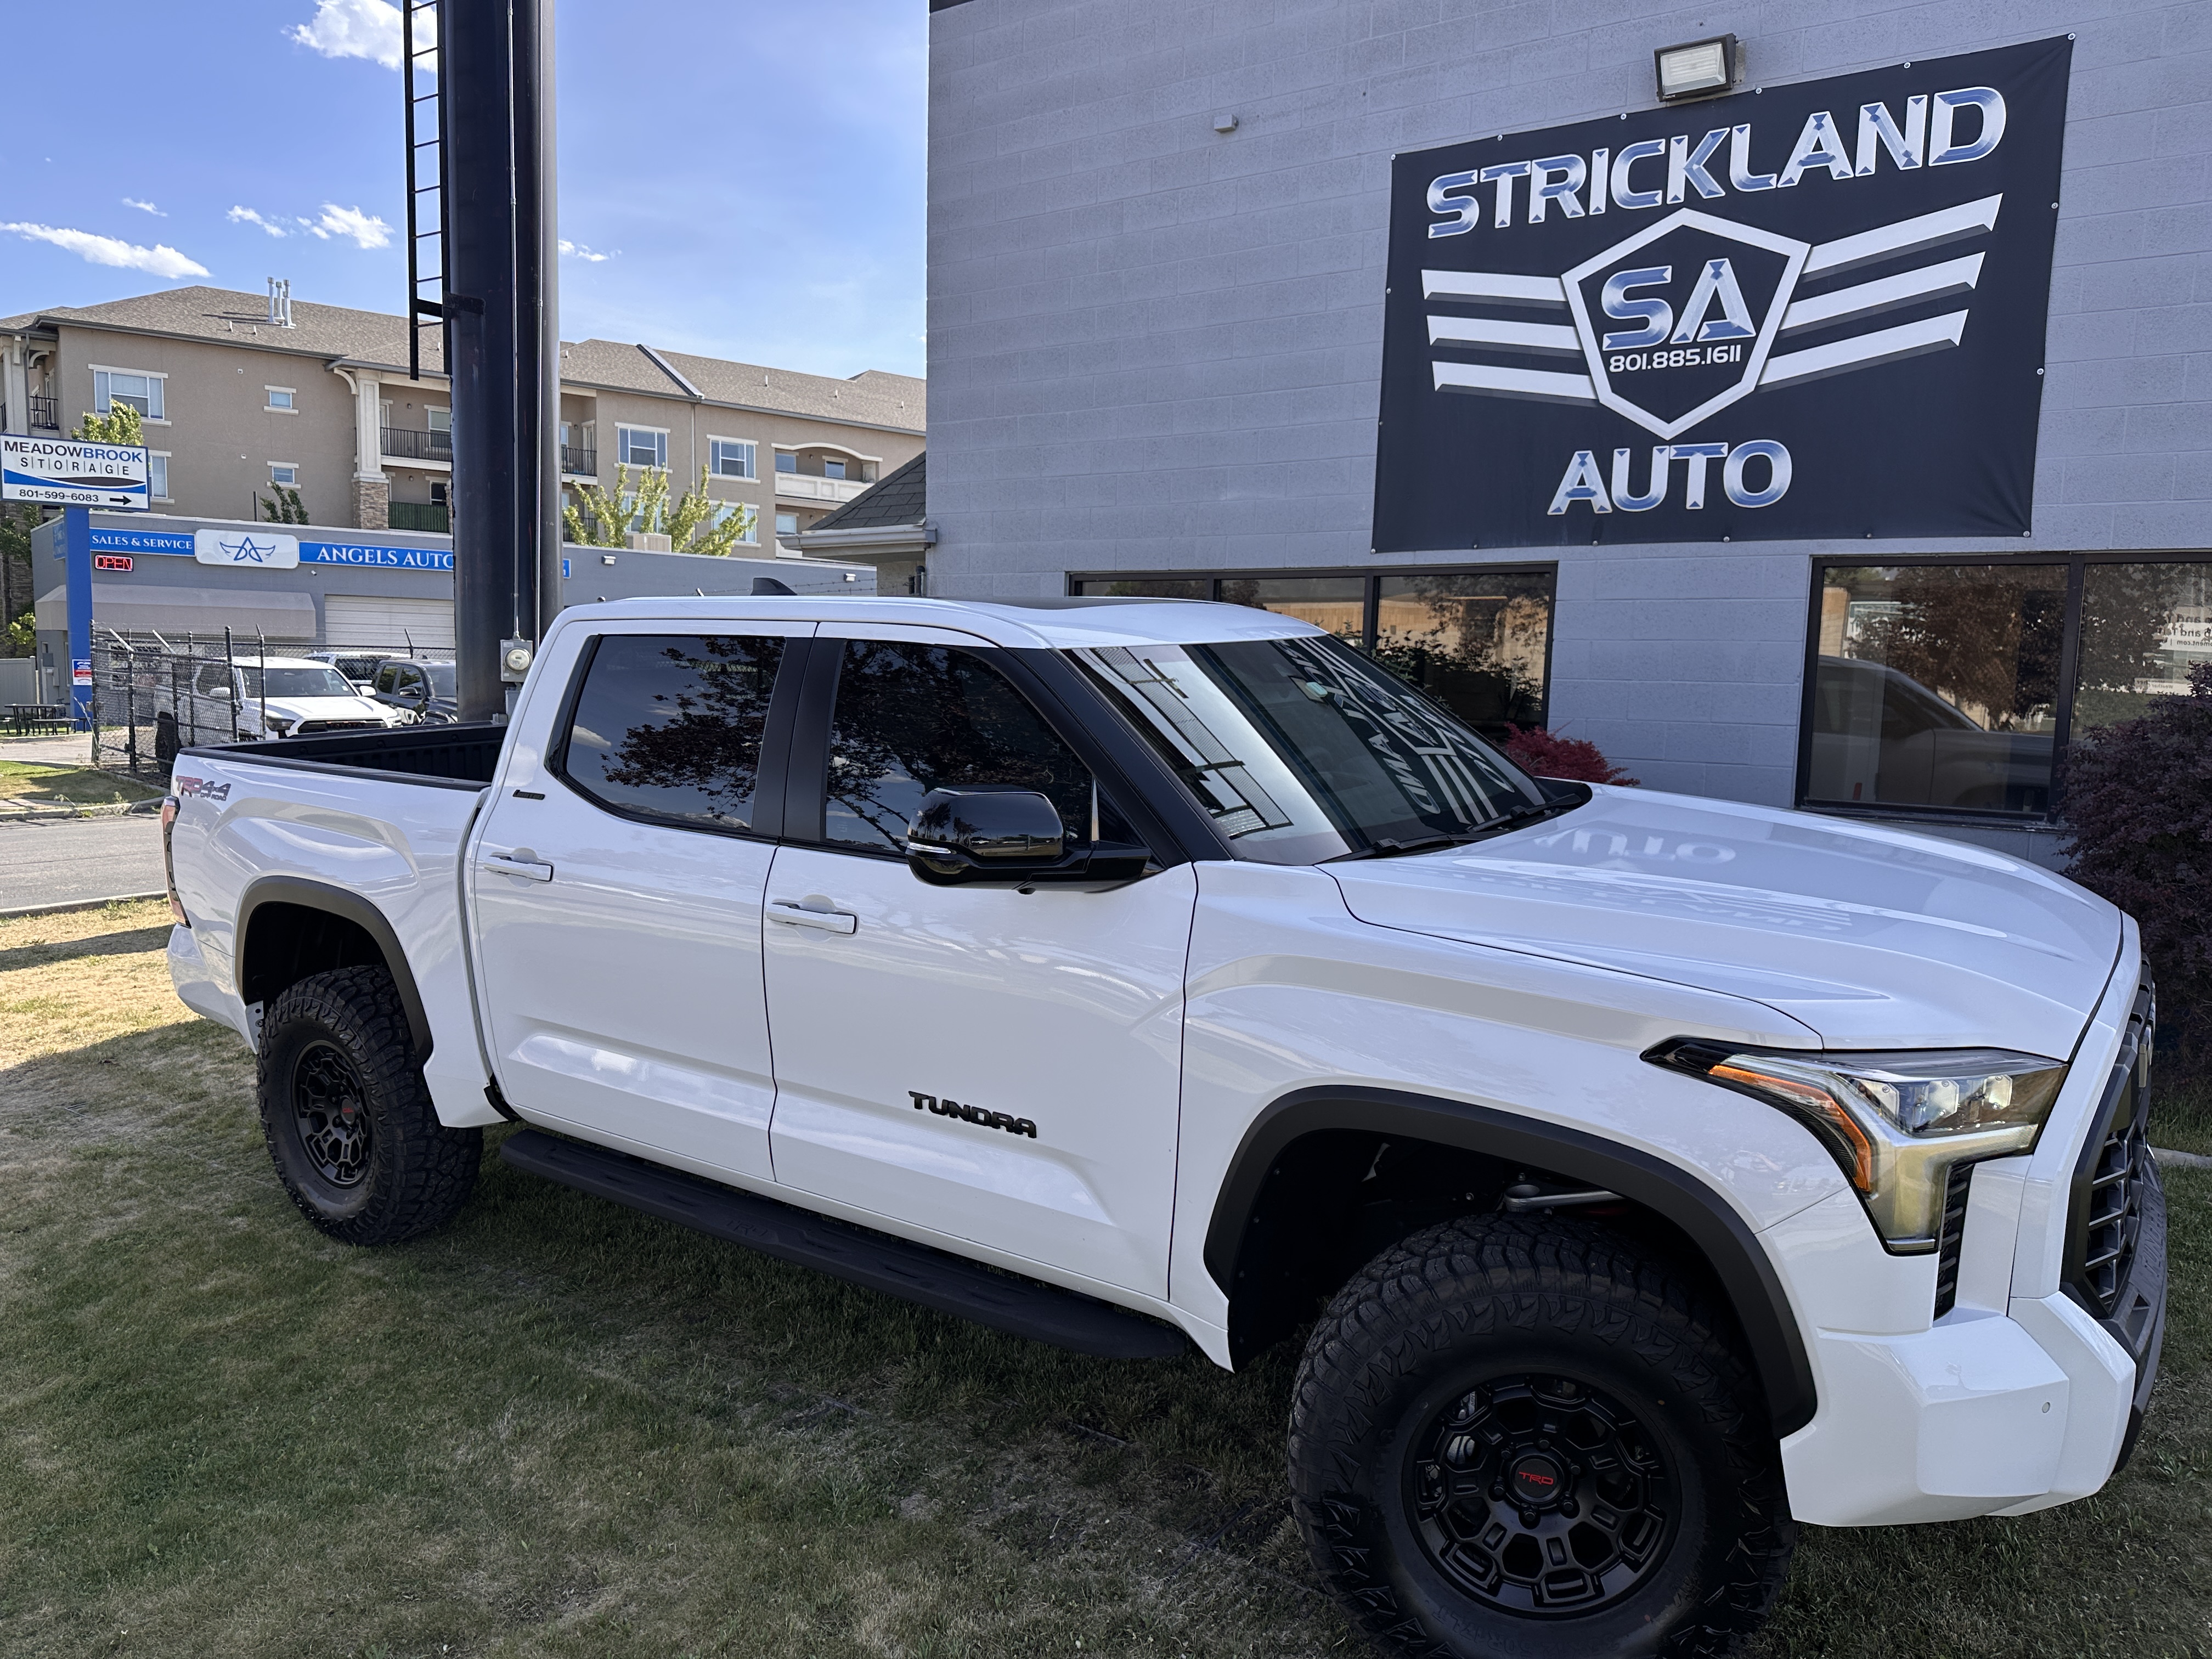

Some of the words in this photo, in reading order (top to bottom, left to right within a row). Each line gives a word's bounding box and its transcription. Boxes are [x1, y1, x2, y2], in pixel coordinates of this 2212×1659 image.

[1426, 85, 2007, 240] STRICKLAND
[1601, 257, 1756, 352] SA
[1609, 344, 1741, 374] 801.885.1611
[4, 440, 143, 463] MEADOWBROOK
[1547, 439, 1793, 515] AUTO
[19, 488, 99, 503] 801-599-6083
[92, 535, 128, 546] SALES
[131, 537, 141, 547] &
[143, 538, 193, 550] SERVICE
[97, 556, 132, 570] OPEN
[317, 545, 398, 565] ANGELS
[908, 1091, 1037, 1138] TUNDRA
[1519, 1471, 1554, 1486] TRD
